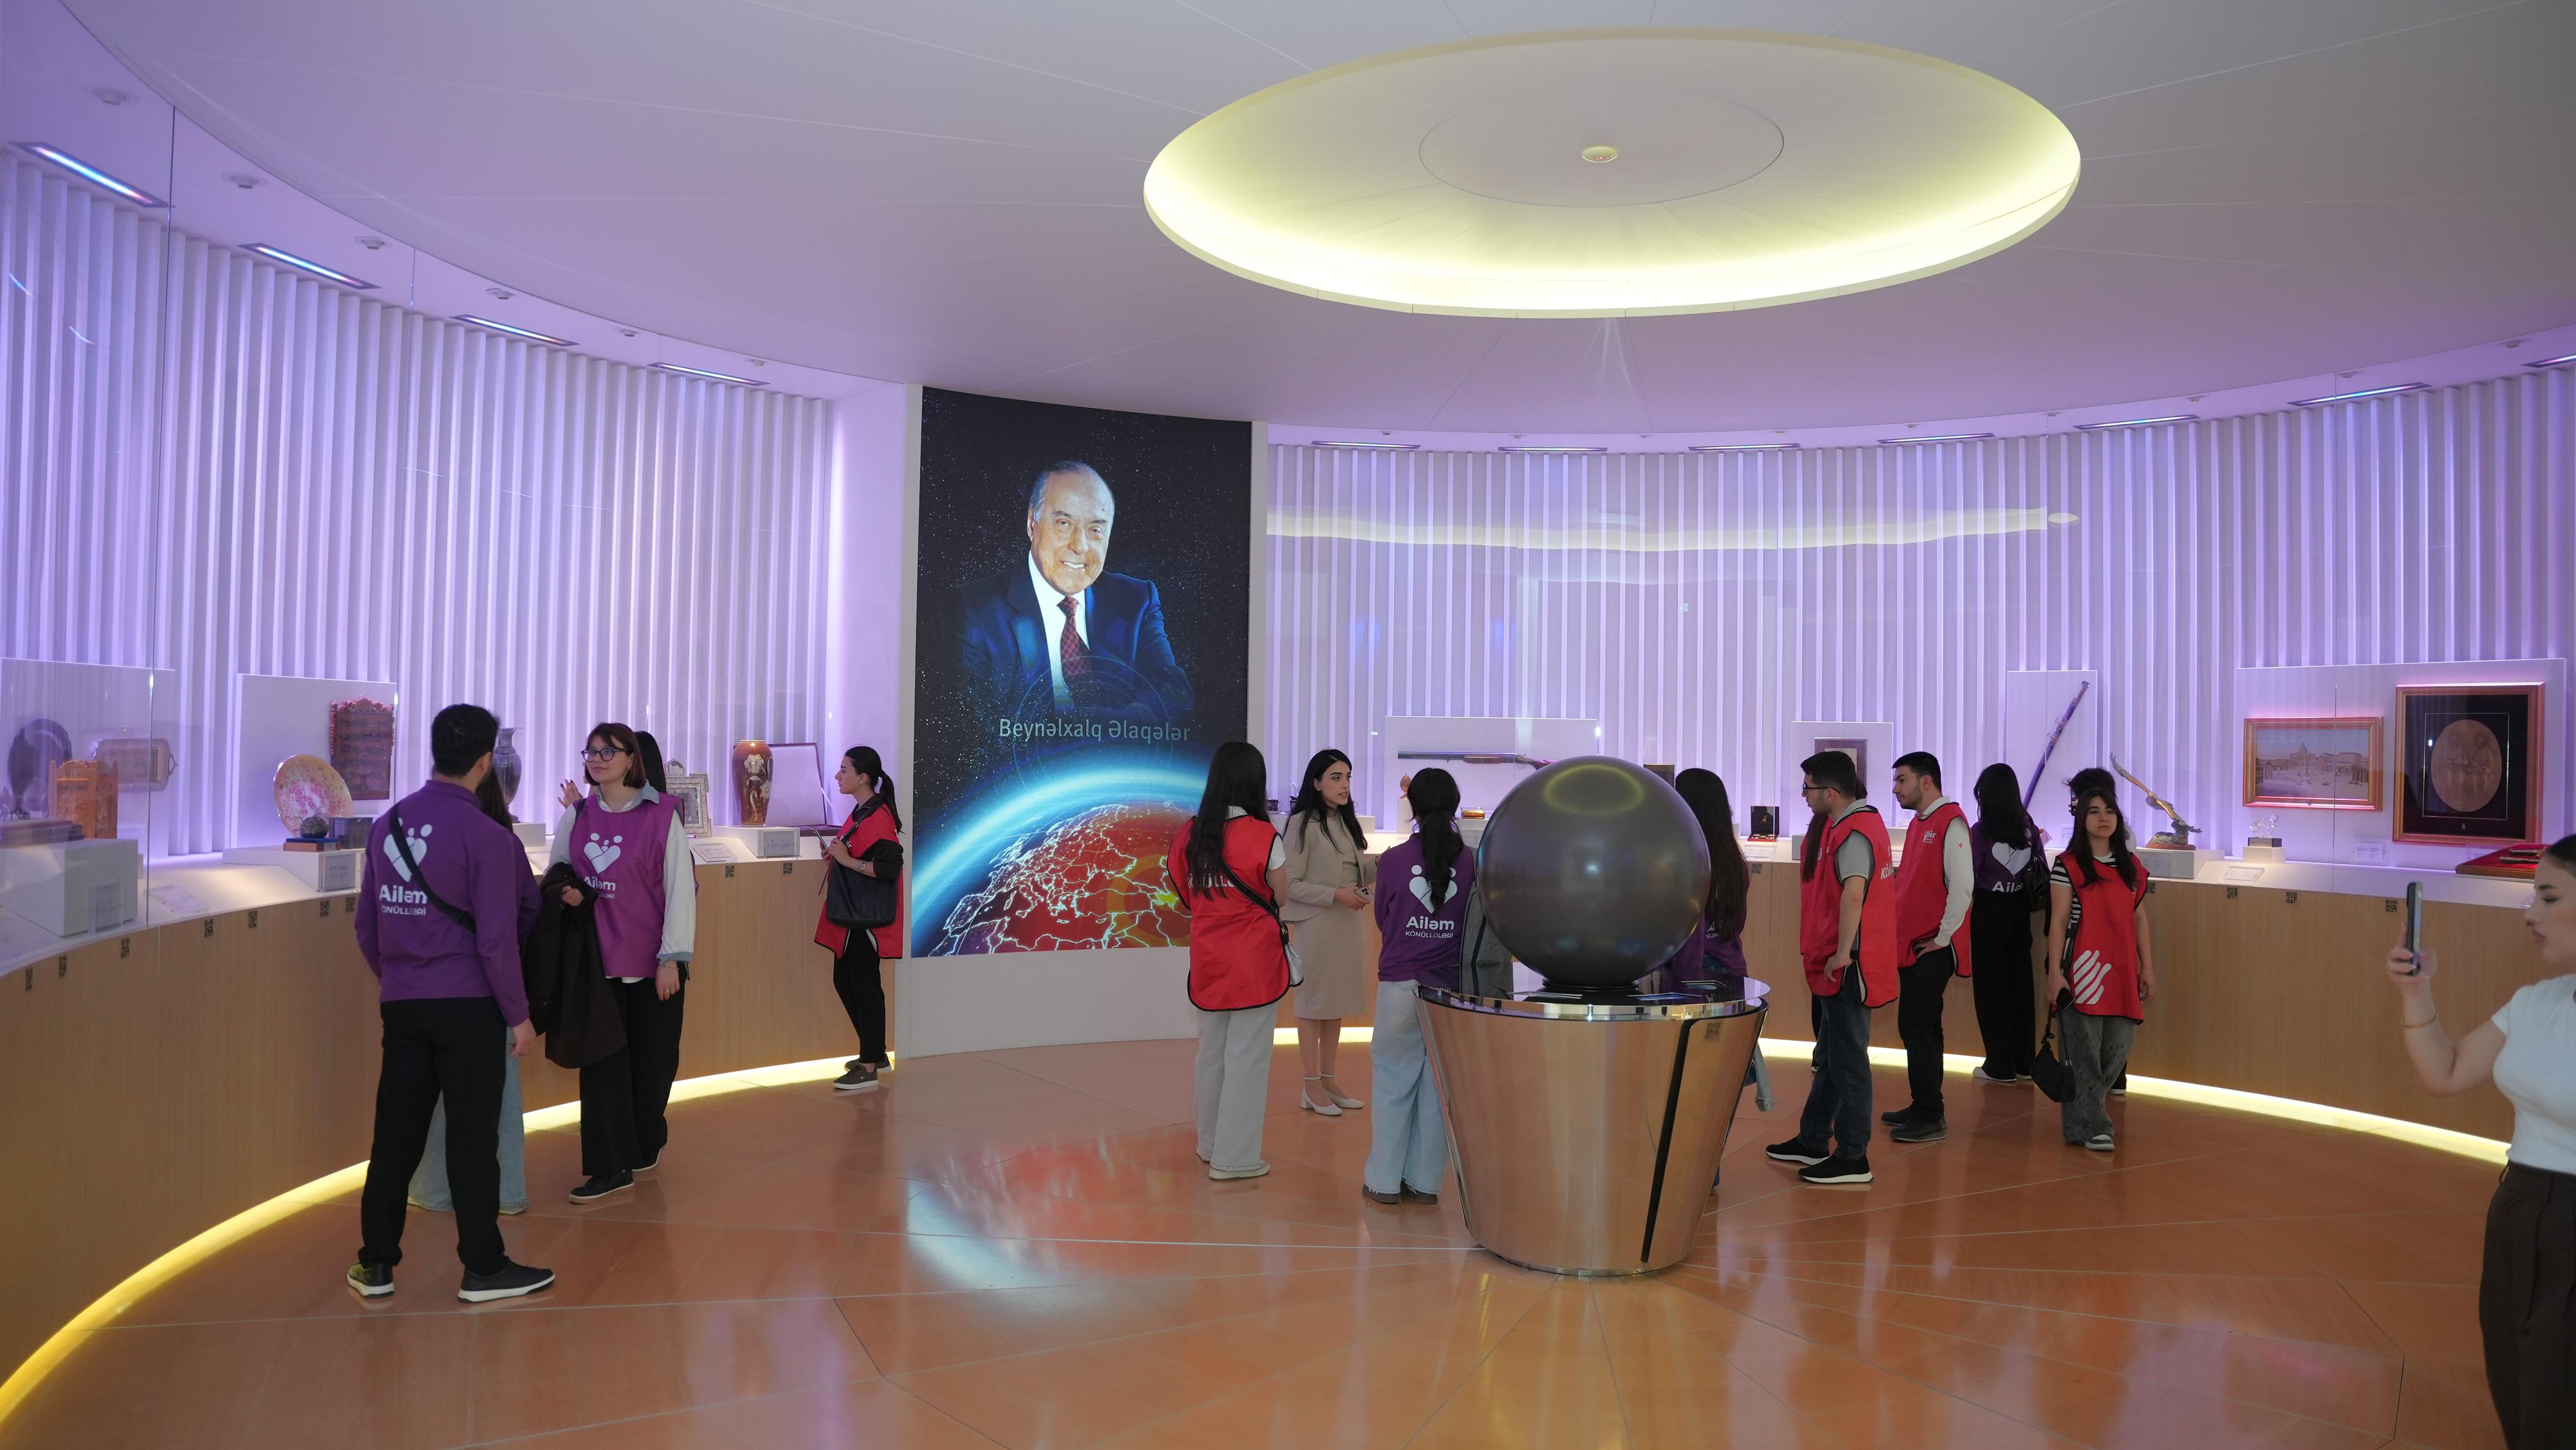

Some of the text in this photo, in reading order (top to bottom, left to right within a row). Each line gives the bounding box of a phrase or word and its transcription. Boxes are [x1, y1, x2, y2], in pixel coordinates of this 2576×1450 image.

[999, 718, 1190, 744] Beynəlxalq Əlaqələr
[584, 876, 616, 891] Ailəm
[379, 885, 428, 904] Ailəm
[1406, 916, 1455, 930] Ailəm
[1405, 931, 1453, 939] KÖNÜLLÜLƏRİ
